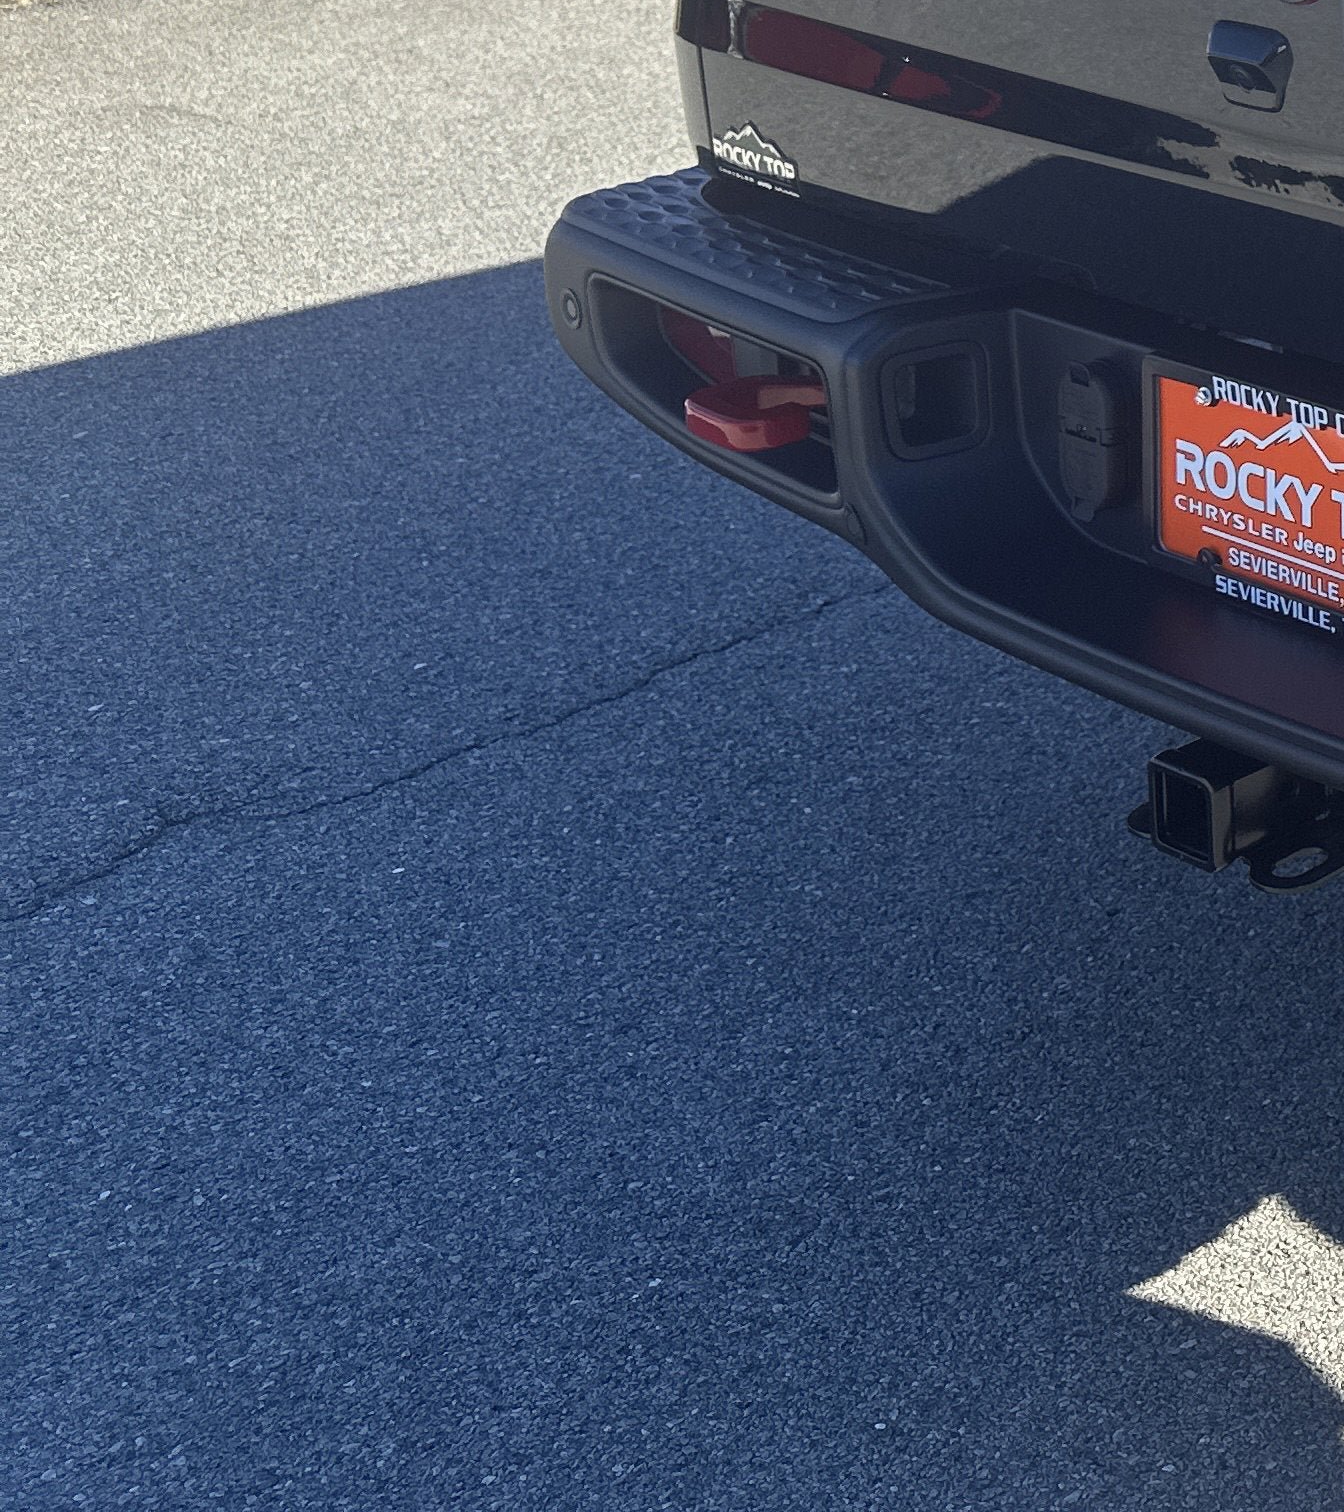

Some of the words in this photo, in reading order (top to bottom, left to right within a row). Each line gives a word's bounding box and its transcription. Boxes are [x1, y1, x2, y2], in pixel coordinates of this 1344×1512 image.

[712, 137, 761, 172] ROCKY
[763, 155, 796, 180] TOP
[1212, 376, 1279, 418] ROCKY
[1286, 398, 1329, 430] TOP
[1175, 438, 1324, 528] ROCKY
[1174, 494, 1289, 546] CHRYSLER
[1293, 531, 1337, 564] Jeep
[1215, 574, 1336, 634] SEVIERVILLE,
[1228, 547, 1344, 608] SEVIERVILLE,
